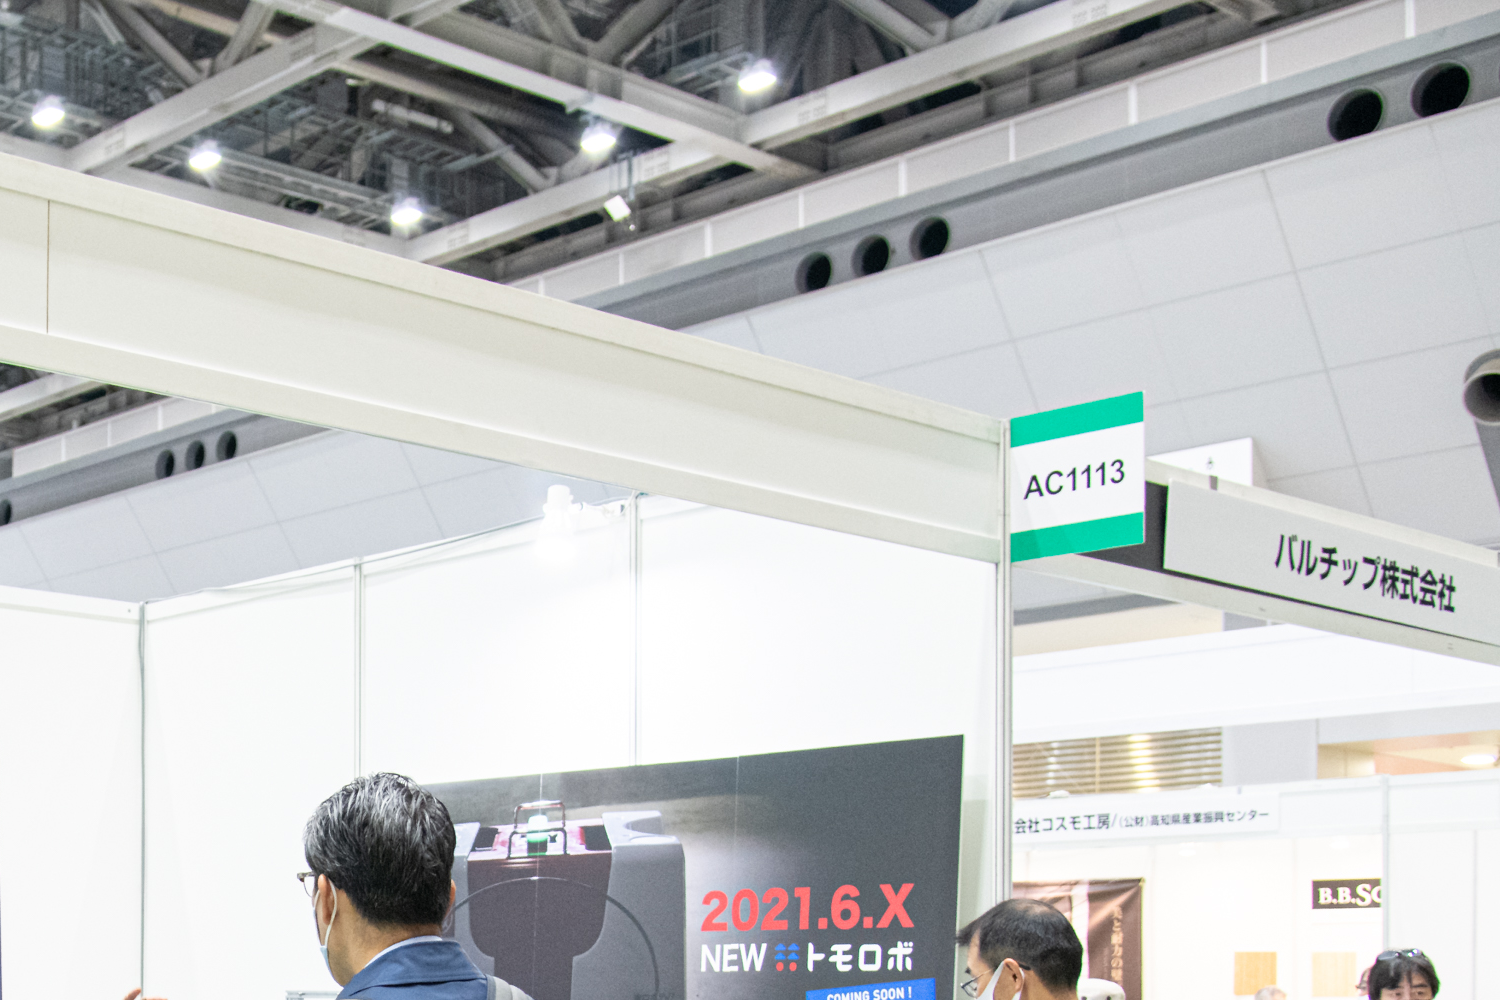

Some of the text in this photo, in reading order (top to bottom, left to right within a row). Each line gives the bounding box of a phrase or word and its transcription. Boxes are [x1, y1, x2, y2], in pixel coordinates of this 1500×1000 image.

[1023, 458, 1126, 500] AC1113
[1274, 532, 1456, 613] バルチップ株式会社
[700, 883, 915, 932] 2021.6.X
[700, 942, 768, 973] NEW
[807, 940, 914, 973] トモロボ
